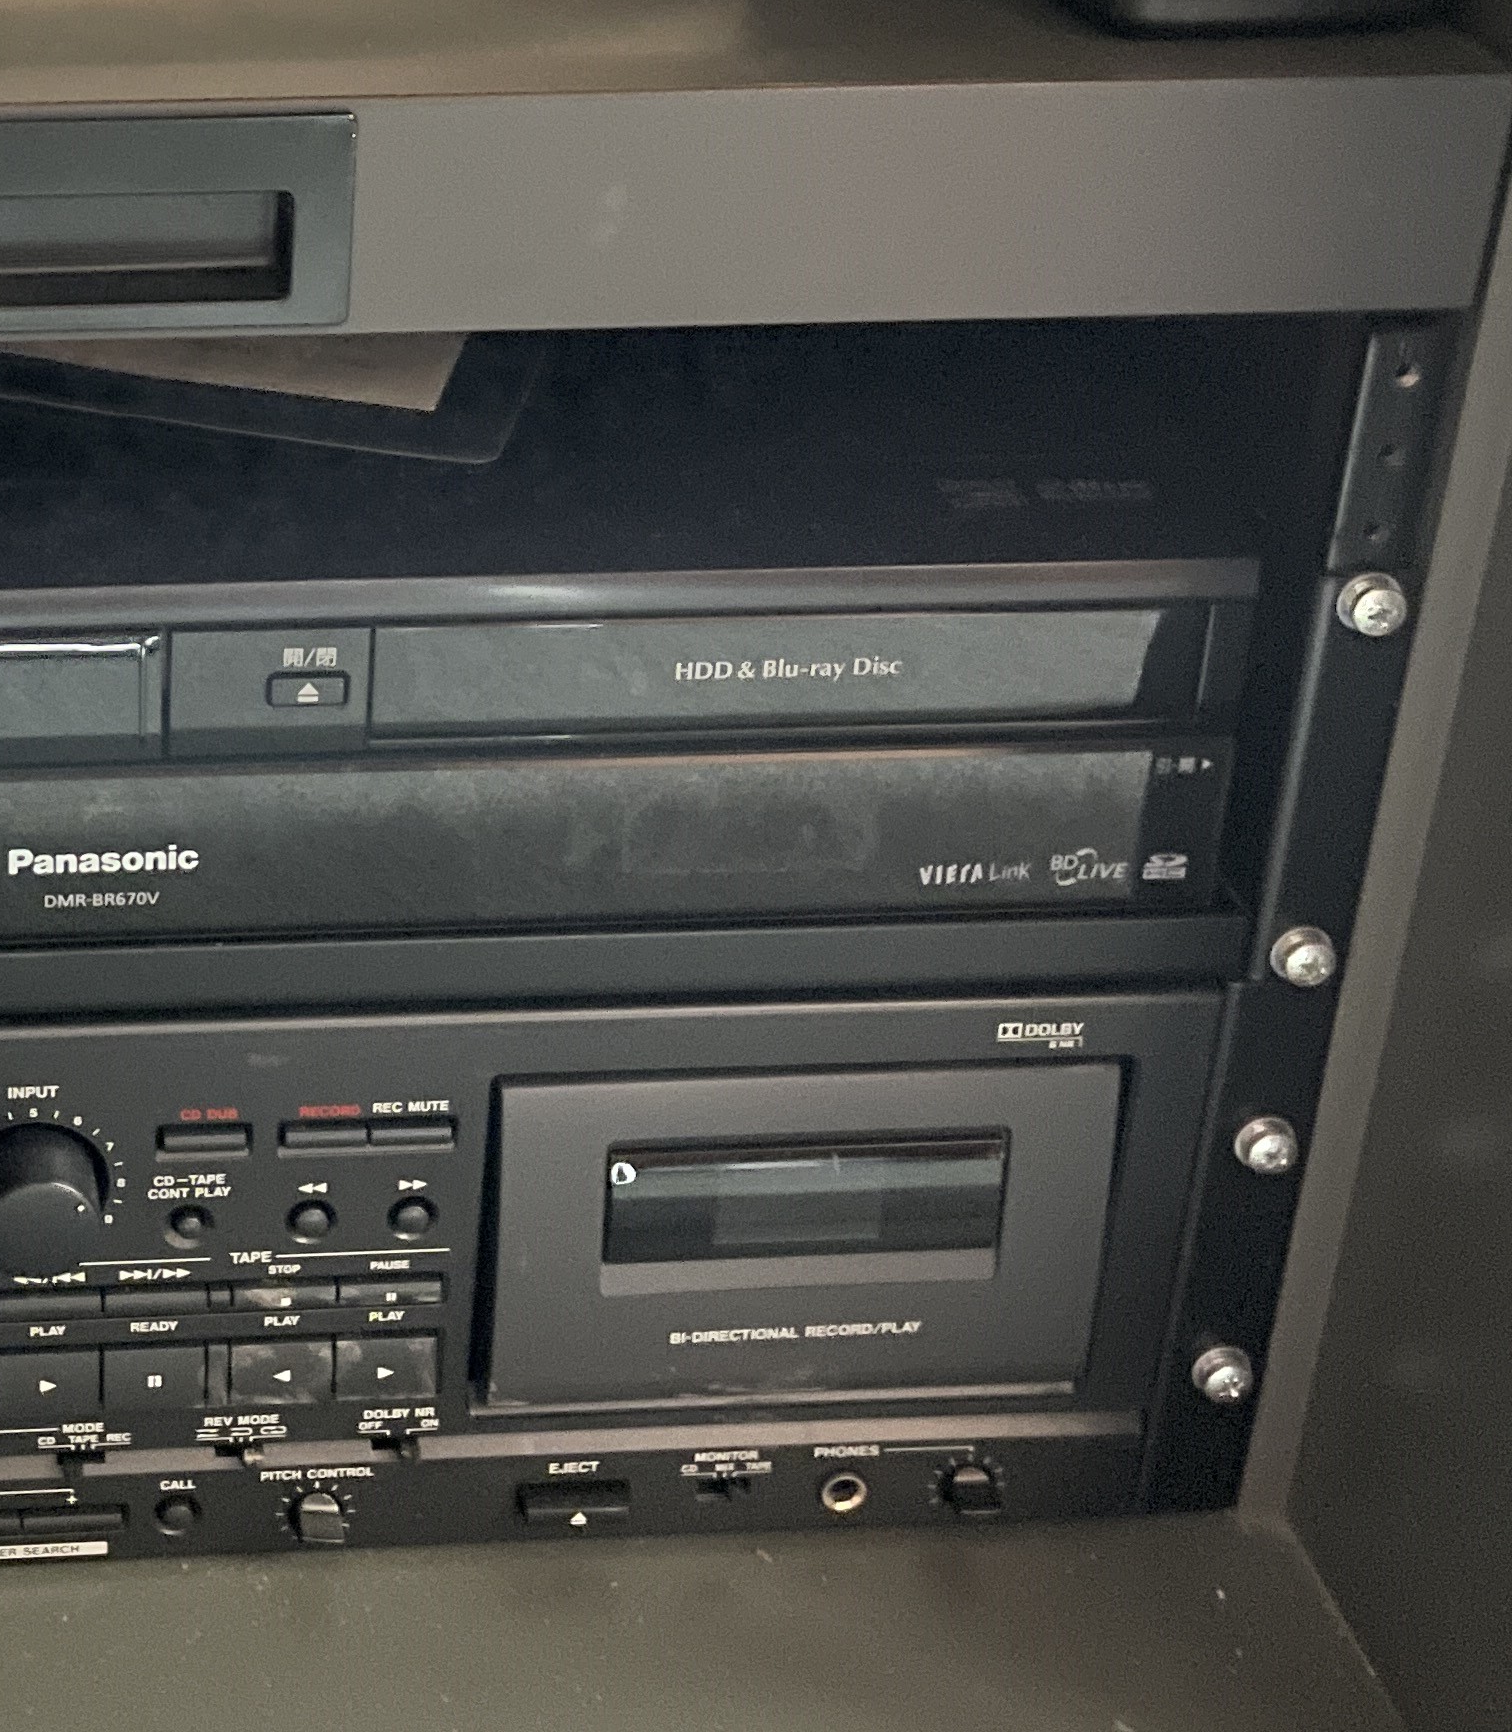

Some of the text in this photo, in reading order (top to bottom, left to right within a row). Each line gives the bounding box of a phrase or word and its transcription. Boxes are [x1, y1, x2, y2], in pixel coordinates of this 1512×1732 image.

[675, 655, 903, 681] HDD & Blu-ray Disc
[7, 844, 200, 875] Panasonic
[1076, 862, 1129, 880] LIVE
[43, 891, 160, 909] DMR-BR670V
[1024, 1022, 1085, 1037] DOLBY
[7, 1085, 59, 1099] INPUT
[29, 1107, 39, 1118] 5
[372, 1100, 450, 1115] REC MUTE
[73, 1115, 83, 1126] 6
[105, 1141, 115, 1152] 7
[115, 1177, 126, 1188] 8
[148, 1186, 232, 1200] CONT PLAY
[229, 1251, 273, 1265] TAPE
[268, 1264, 301, 1275] STOP
[369, 1260, 410, 1271] PAUSE
[264, 1315, 301, 1327] PLAY
[368, 1310, 406, 1322] PLAY
[29, 1324, 67, 1337] PLAY
[129, 1320, 178, 1333] READY
[669, 1320, 922, 1345] BI-DIRECTIONAL RECORD/PLAY
[363, 1406, 436, 1421] DOLBY NR
[204, 1413, 280, 1428] REV MODE
[358, 1421, 383, 1431] OFF
[62, 1422, 105, 1434] MODE
[38, 1436, 56, 1446] CD
[68, 1433, 99, 1444] TAPE
[106, 1432, 132, 1443] REC
[694, 1450, 760, 1463] MONITOR
[813, 1444, 880, 1459] PHONES
[548, 1460, 600, 1475] EJECT
[260, 1467, 375, 1482] PITCH CONTROL
[159, 1480, 197, 1491] CALL
[23, 1542, 81, 1556] SEARCH
